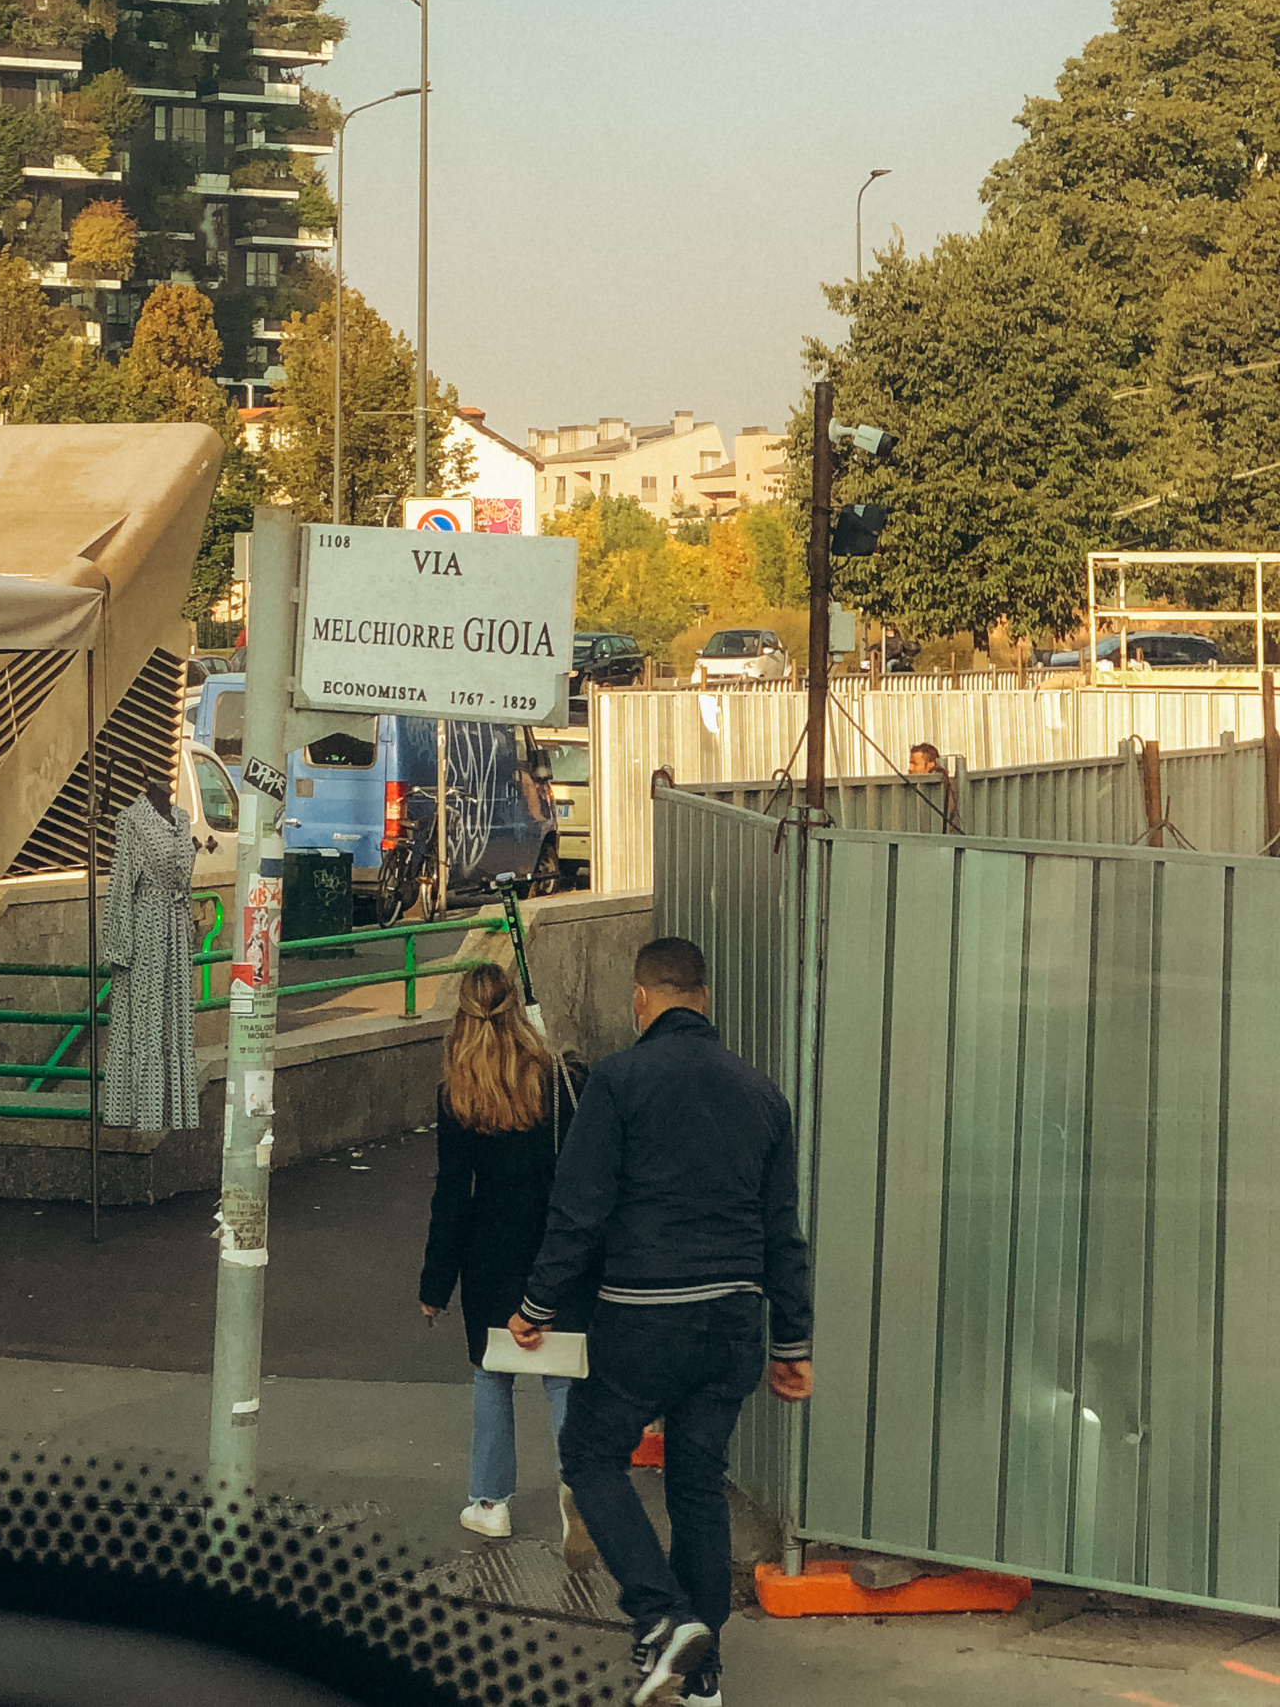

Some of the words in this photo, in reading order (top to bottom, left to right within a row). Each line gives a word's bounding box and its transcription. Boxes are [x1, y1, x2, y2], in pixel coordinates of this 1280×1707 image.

[318, 534, 351, 549] 1108
[411, 550, 463, 576] VIA
[312, 617, 455, 650] MELCHIORRE
[463, 616, 556, 658] GIOIA
[323, 681, 427, 702] ECONOMISTA
[450, 691, 484, 706] 1767
[502, 695, 537, 711] 1829
